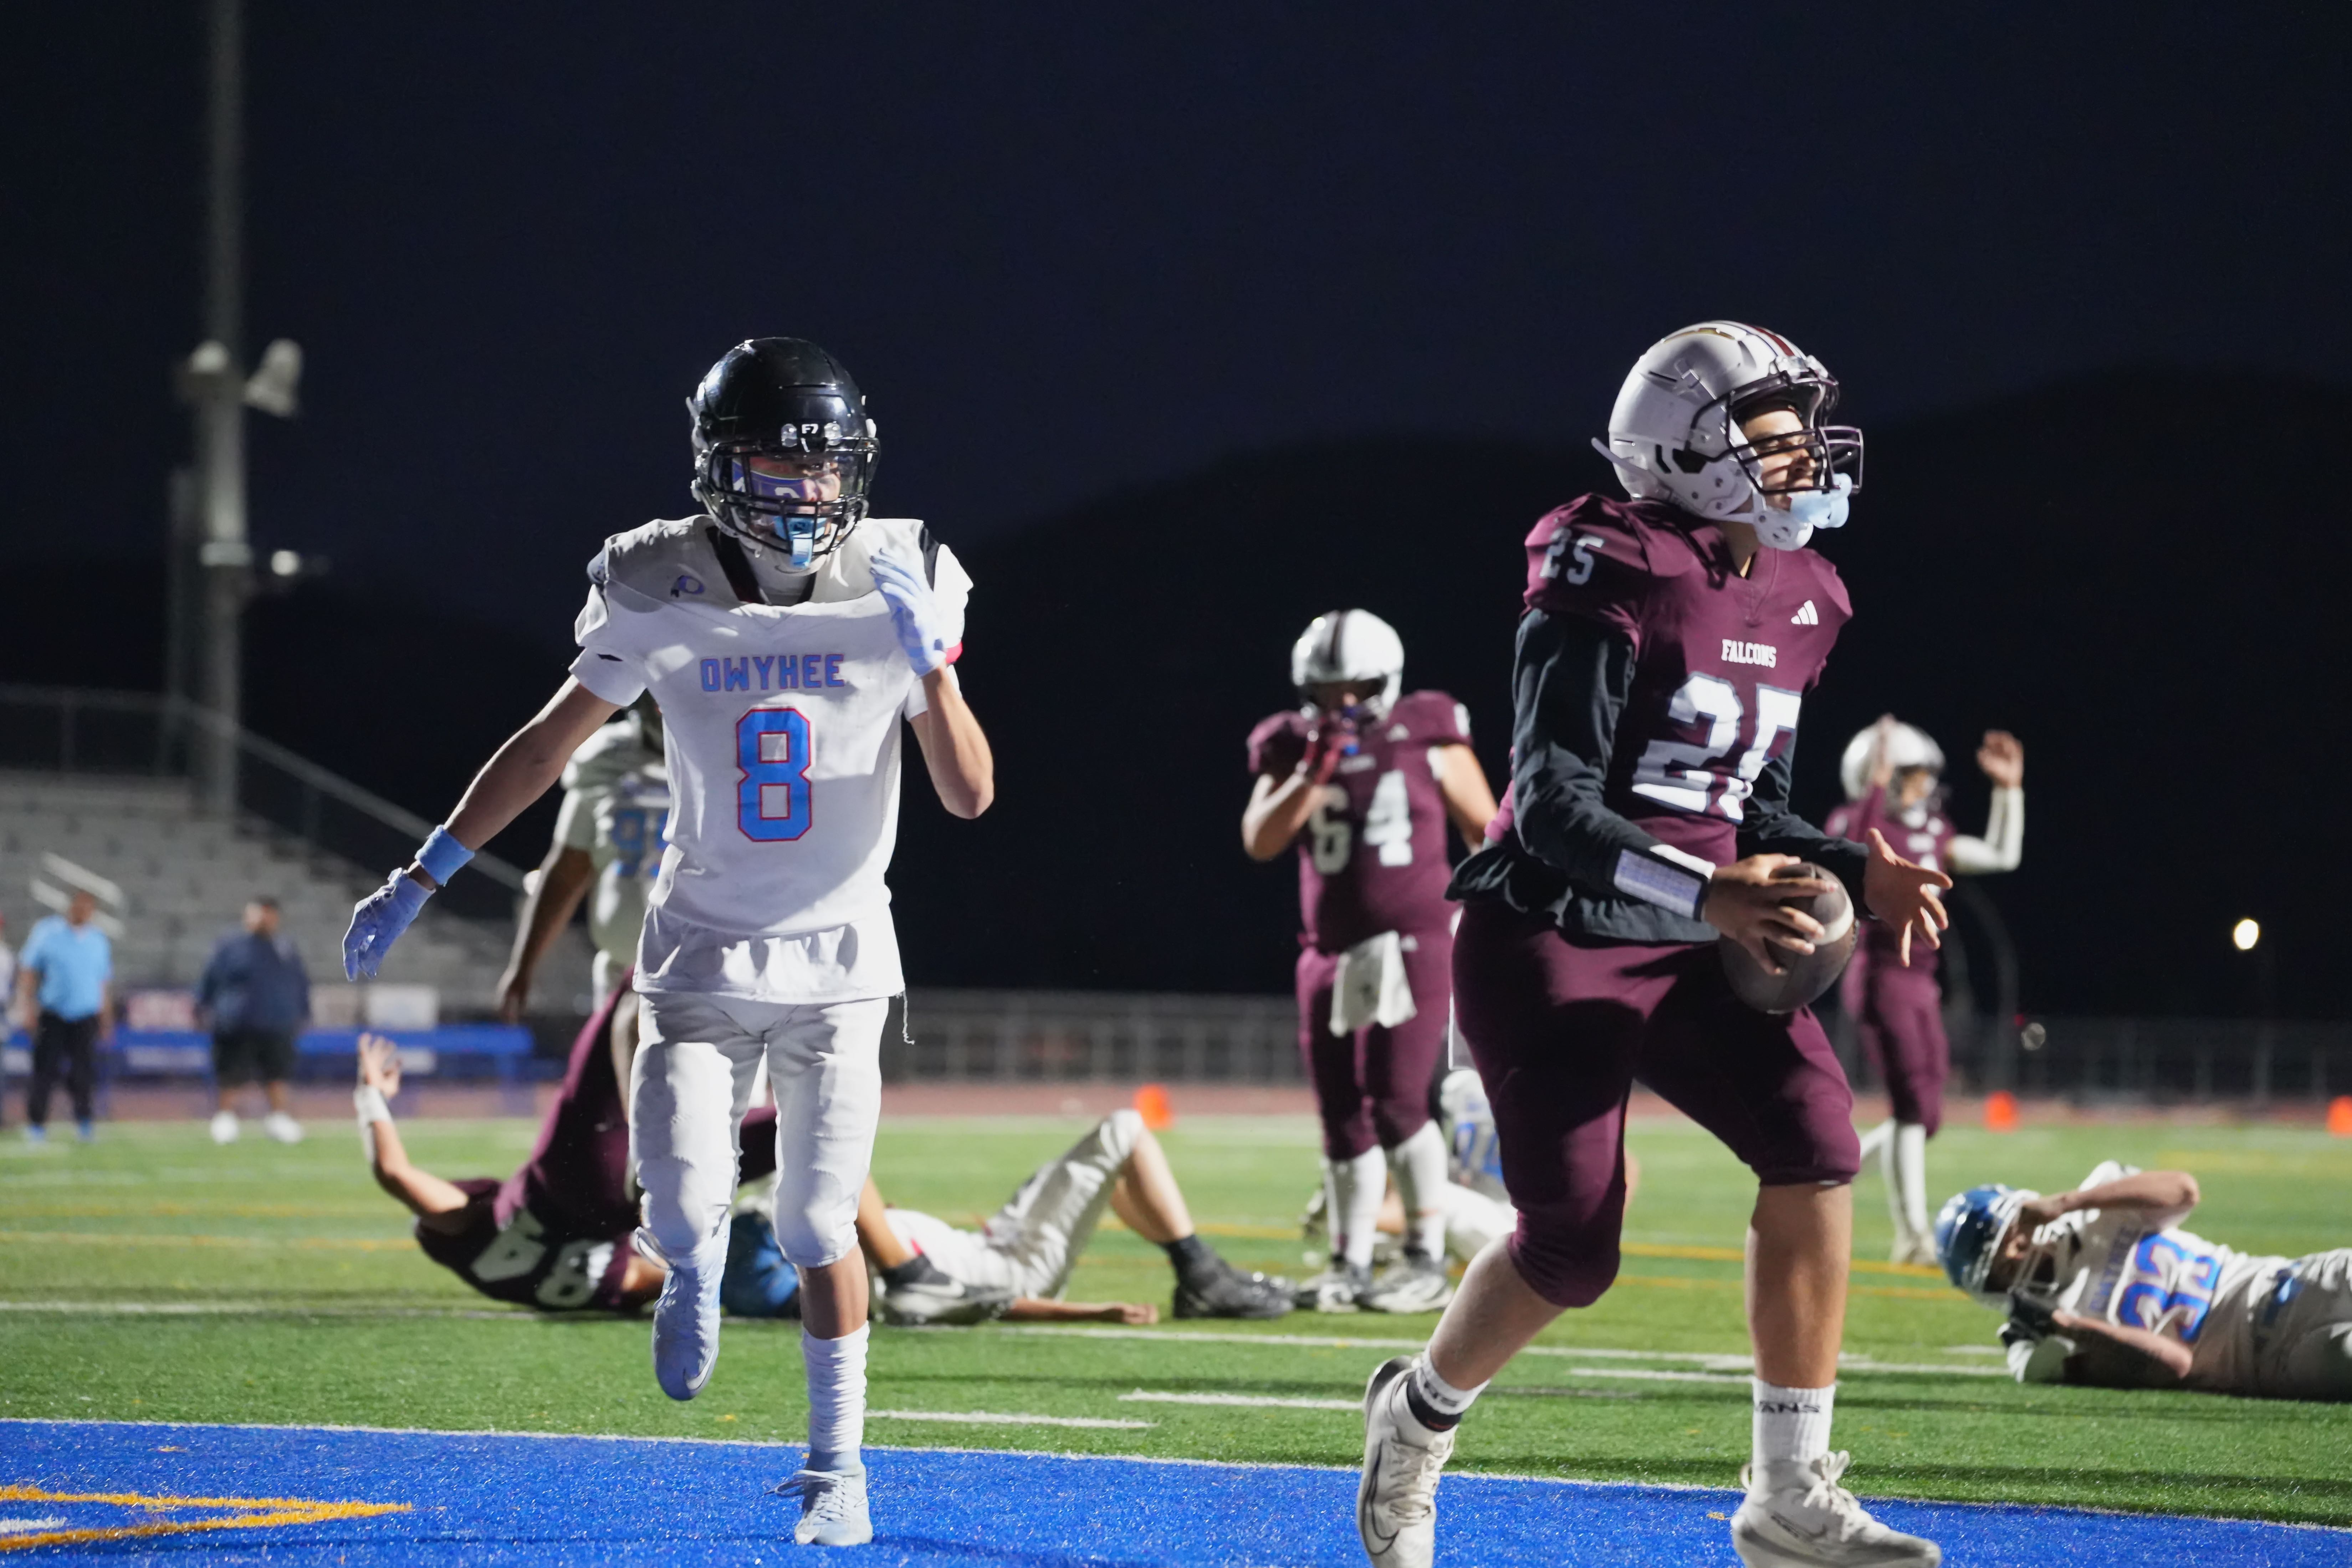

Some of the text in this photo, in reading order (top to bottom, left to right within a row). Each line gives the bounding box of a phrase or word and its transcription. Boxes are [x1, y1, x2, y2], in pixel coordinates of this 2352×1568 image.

[801, 423, 819, 434] F7
[1538, 526, 1605, 585] 25
[700, 654, 845, 692] OWYHEE
[1721, 638, 1777, 668] FALCONS
[736, 708, 812, 842] 8
[1309, 769, 1413, 875] 64
